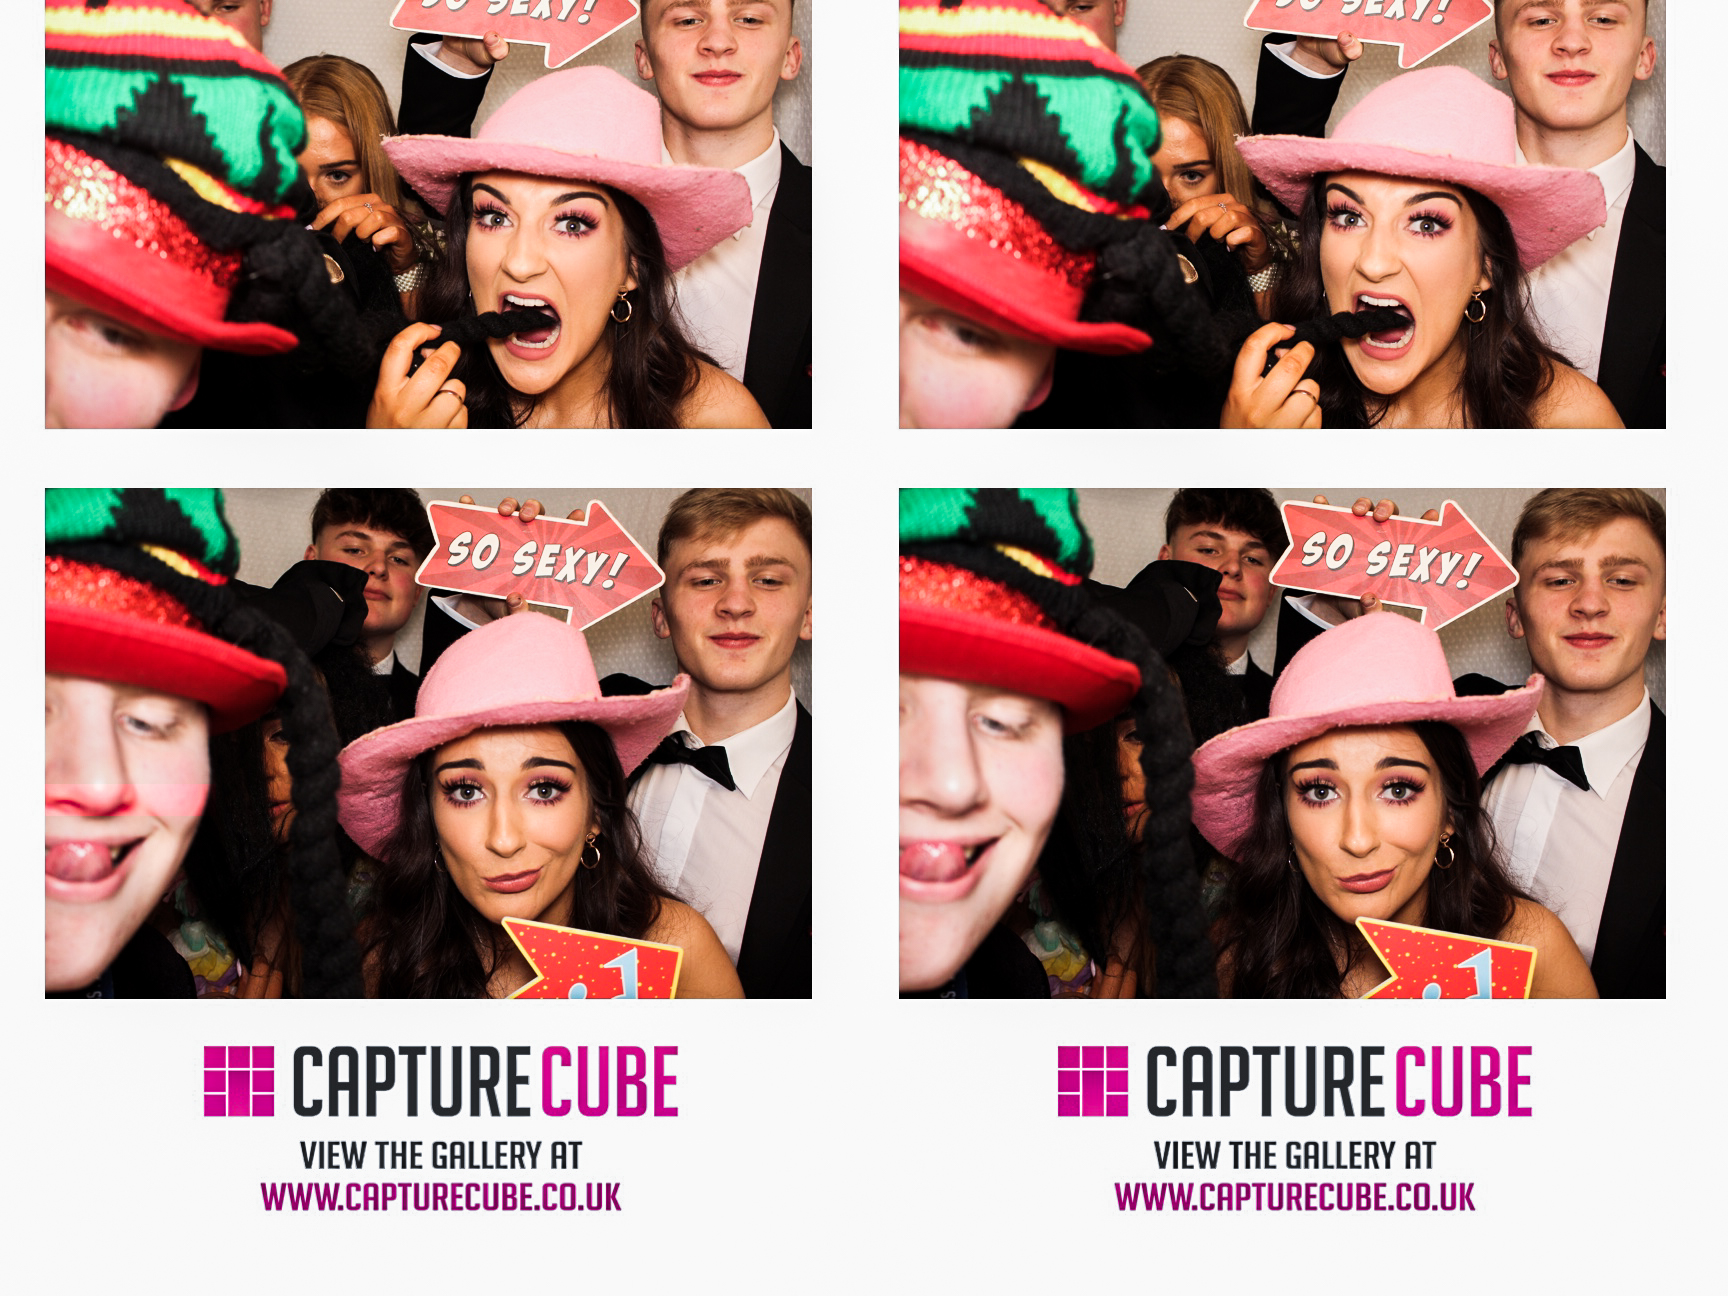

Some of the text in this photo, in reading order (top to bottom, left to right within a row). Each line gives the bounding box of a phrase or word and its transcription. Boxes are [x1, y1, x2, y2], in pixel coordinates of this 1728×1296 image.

[447, 531, 630, 590] SO SEXY!
[1301, 531, 1484, 590] SO SEXY!
